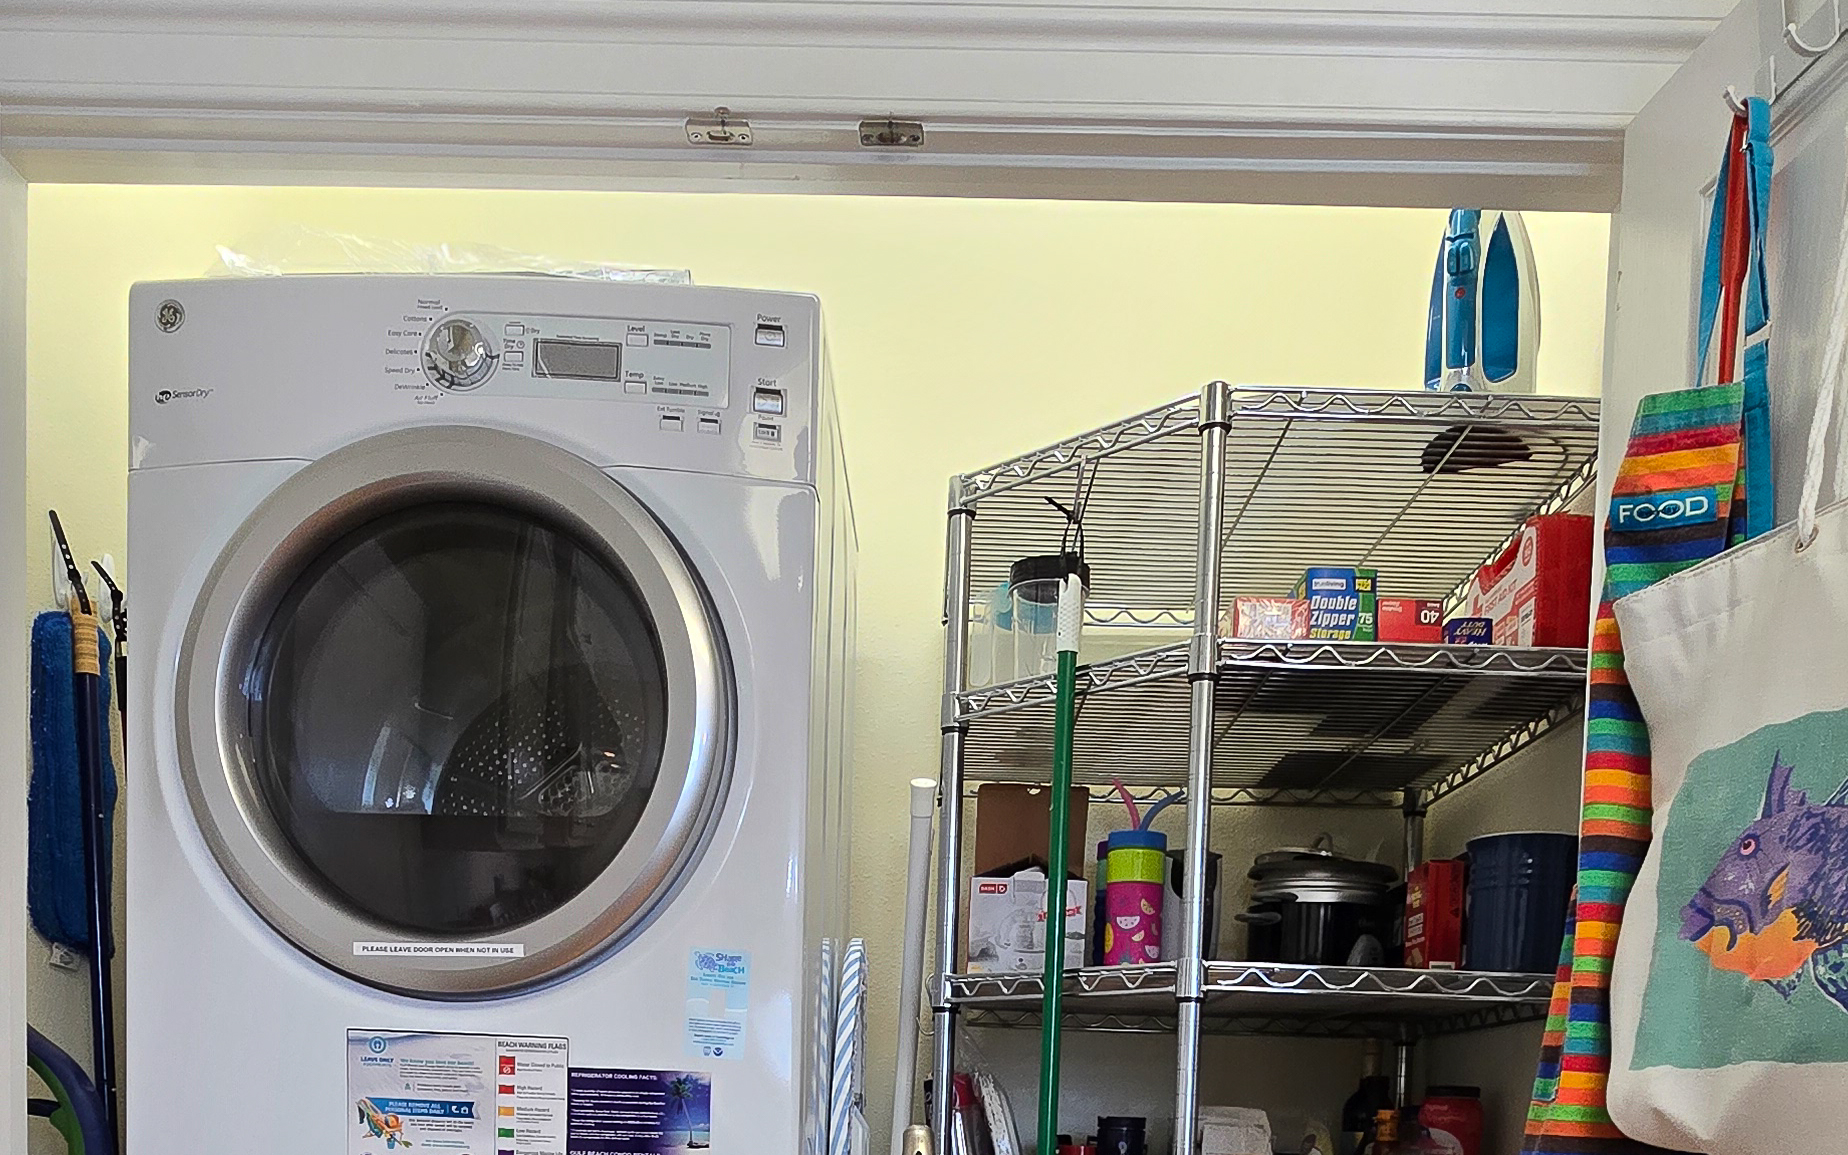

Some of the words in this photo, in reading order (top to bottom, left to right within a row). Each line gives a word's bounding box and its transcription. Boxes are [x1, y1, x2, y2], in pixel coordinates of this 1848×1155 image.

[757, 313, 782, 323] Power
[384, 366, 403, 374] Speed
[625, 370, 645, 379] Temp
[757, 378, 777, 387] Start
[1619, 496, 1709, 524] FOOD
[1310, 595, 1358, 610] Double
[1309, 611, 1356, 628] Zipper
[1358, 612, 1373, 624] 75
[1420, 609, 1440, 624] 40
[1309, 627, 1352, 639] Storage
[518, 1041, 547, 1049] WARNING
[548, 1042, 567, 1050] FLAGS
